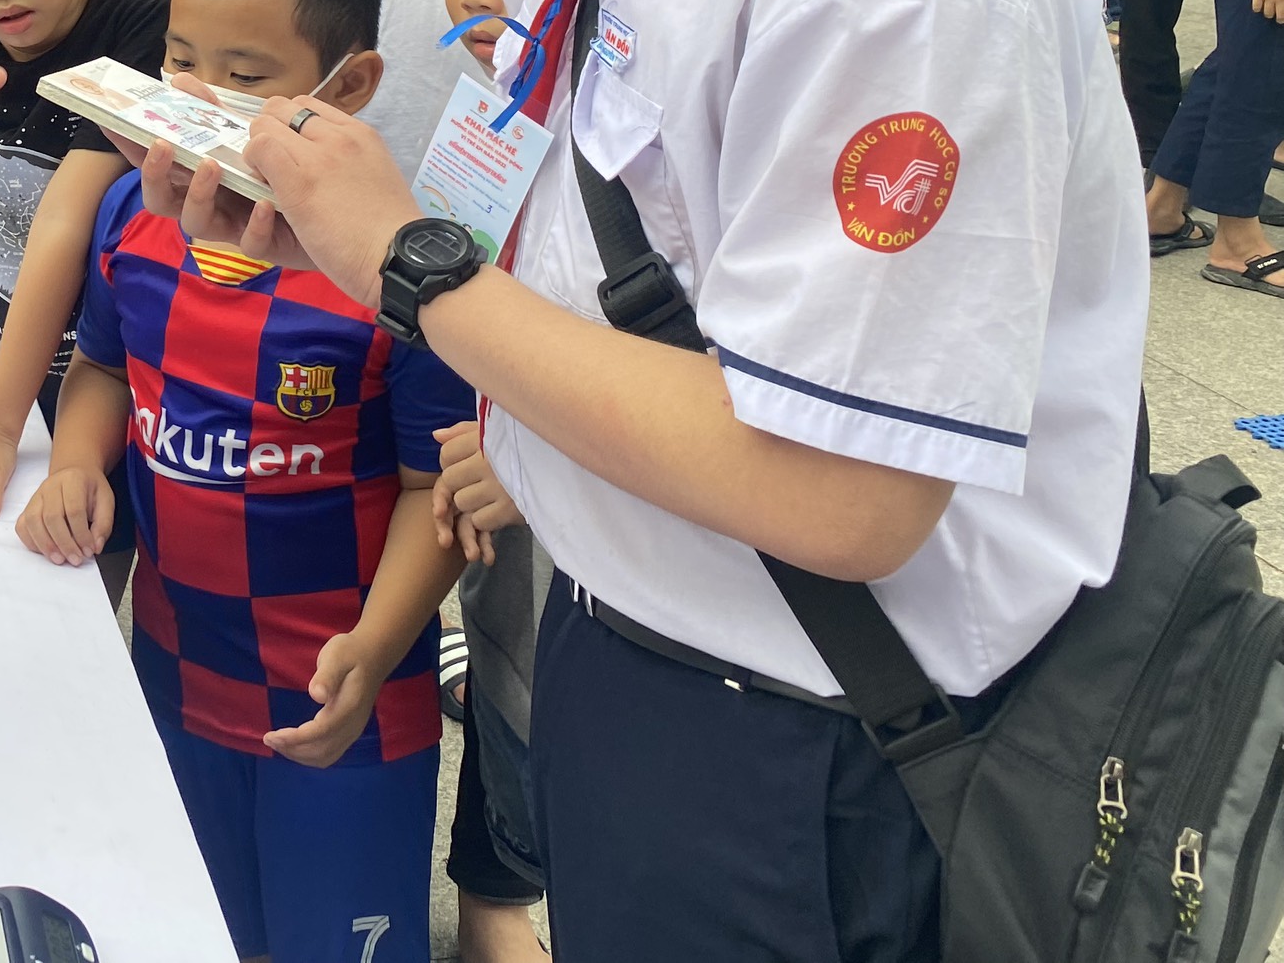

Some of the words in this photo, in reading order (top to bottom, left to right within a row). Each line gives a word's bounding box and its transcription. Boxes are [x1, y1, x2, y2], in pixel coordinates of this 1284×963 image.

[464, 115, 486, 134] KHAI
[842, 132, 878, 194] TRƯỜNG
[878, 118, 927, 137] TRUNG
[929, 127, 954, 158] HỌC
[847, 217, 875, 242] VÂN
[877, 228, 915, 247] ĐỒN
[352, 915, 390, 963] 7
